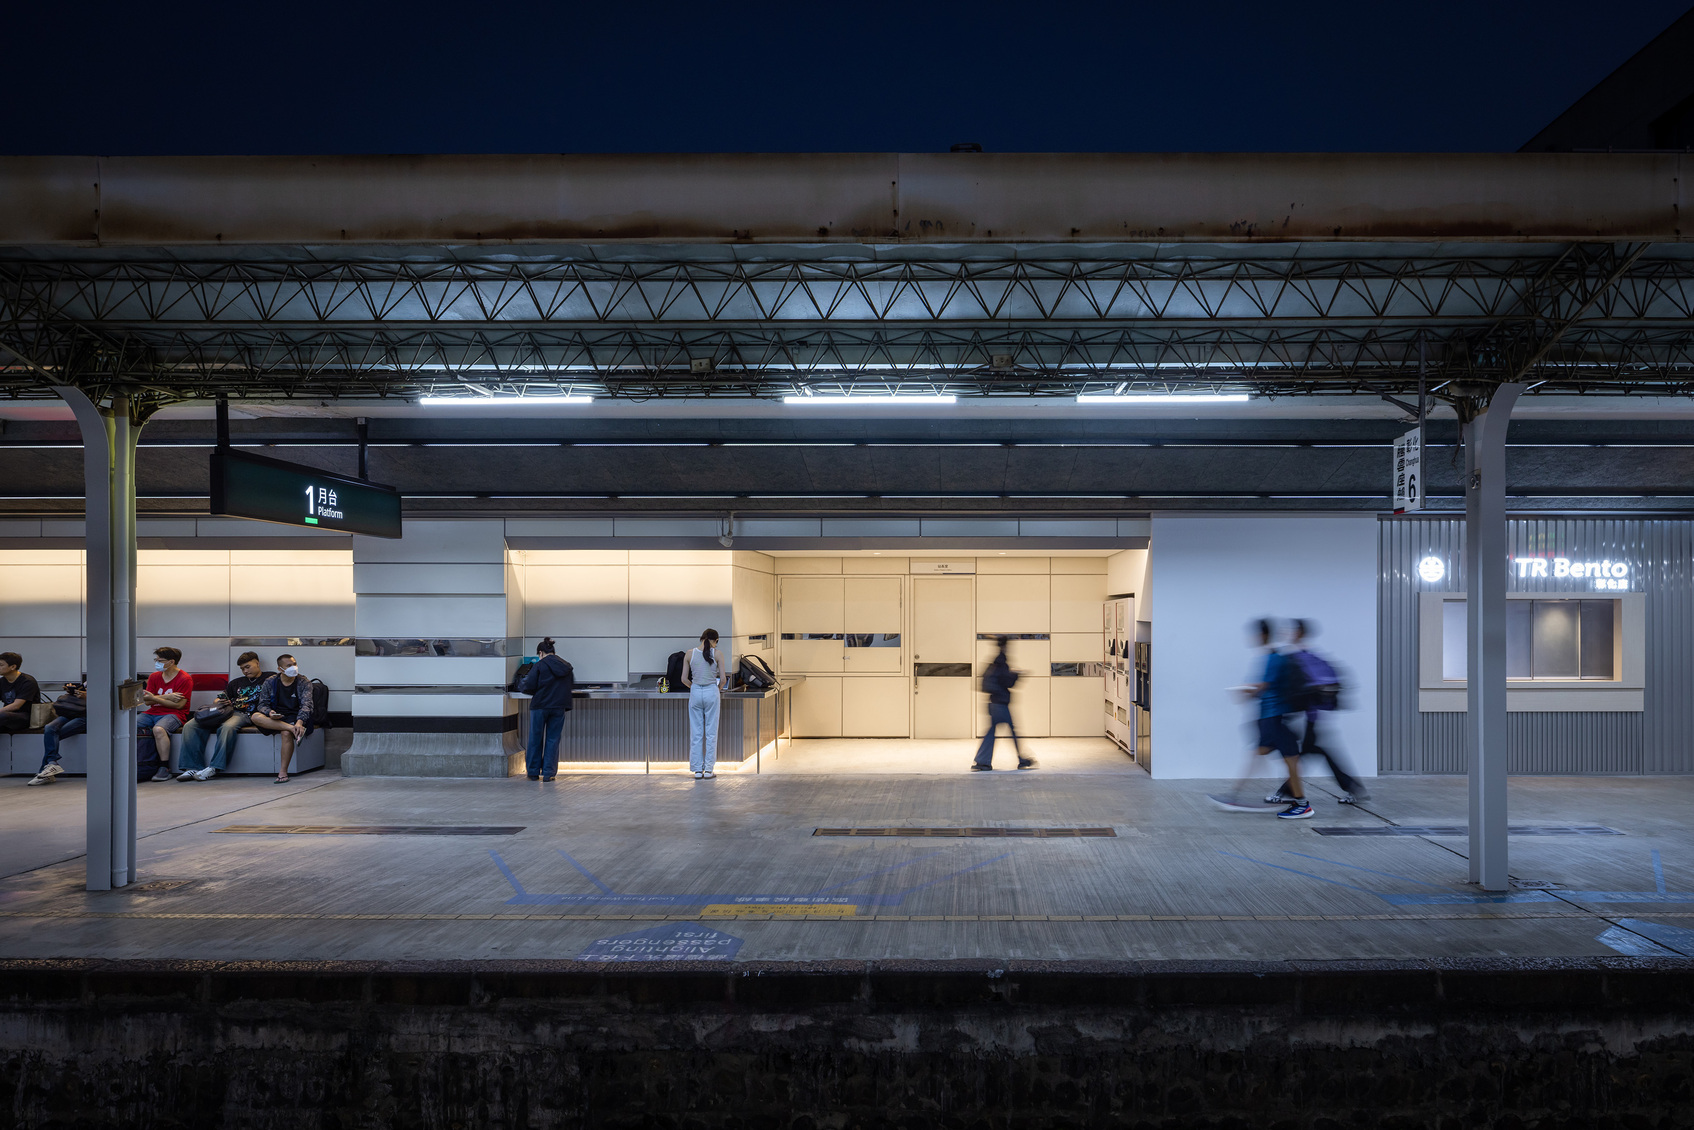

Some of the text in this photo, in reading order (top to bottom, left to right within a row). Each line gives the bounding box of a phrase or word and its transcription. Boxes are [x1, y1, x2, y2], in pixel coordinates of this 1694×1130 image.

[1408, 473, 1416, 503] 6
[305, 485, 338, 515] 1 月台
[318, 506, 344, 519] Platform
[1515, 557, 1628, 578] TR Bento
[596, 938, 732, 946] passengers
[610, 944, 716, 953] Alighting
